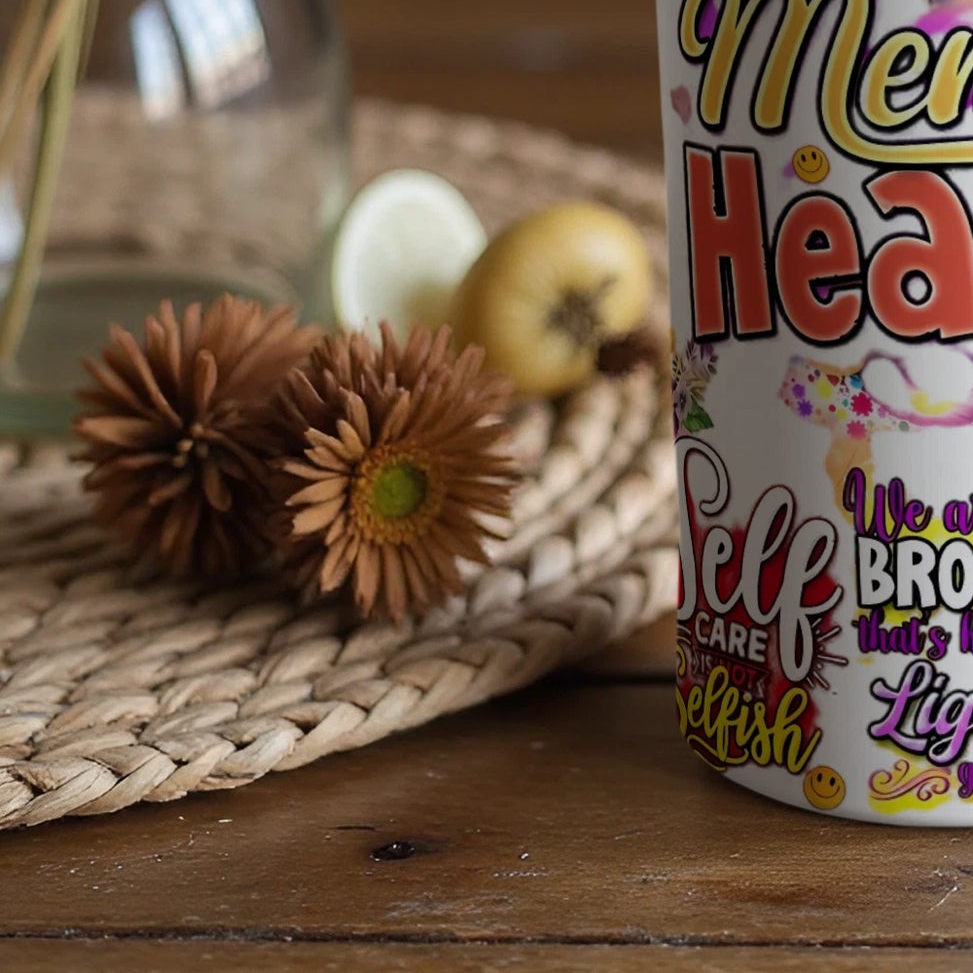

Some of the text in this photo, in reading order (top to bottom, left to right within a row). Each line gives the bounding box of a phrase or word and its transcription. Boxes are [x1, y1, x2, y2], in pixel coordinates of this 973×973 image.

[843, 467, 933, 543] We
[694, 610, 769, 664] CARE
[851, 607, 951, 661] that's
